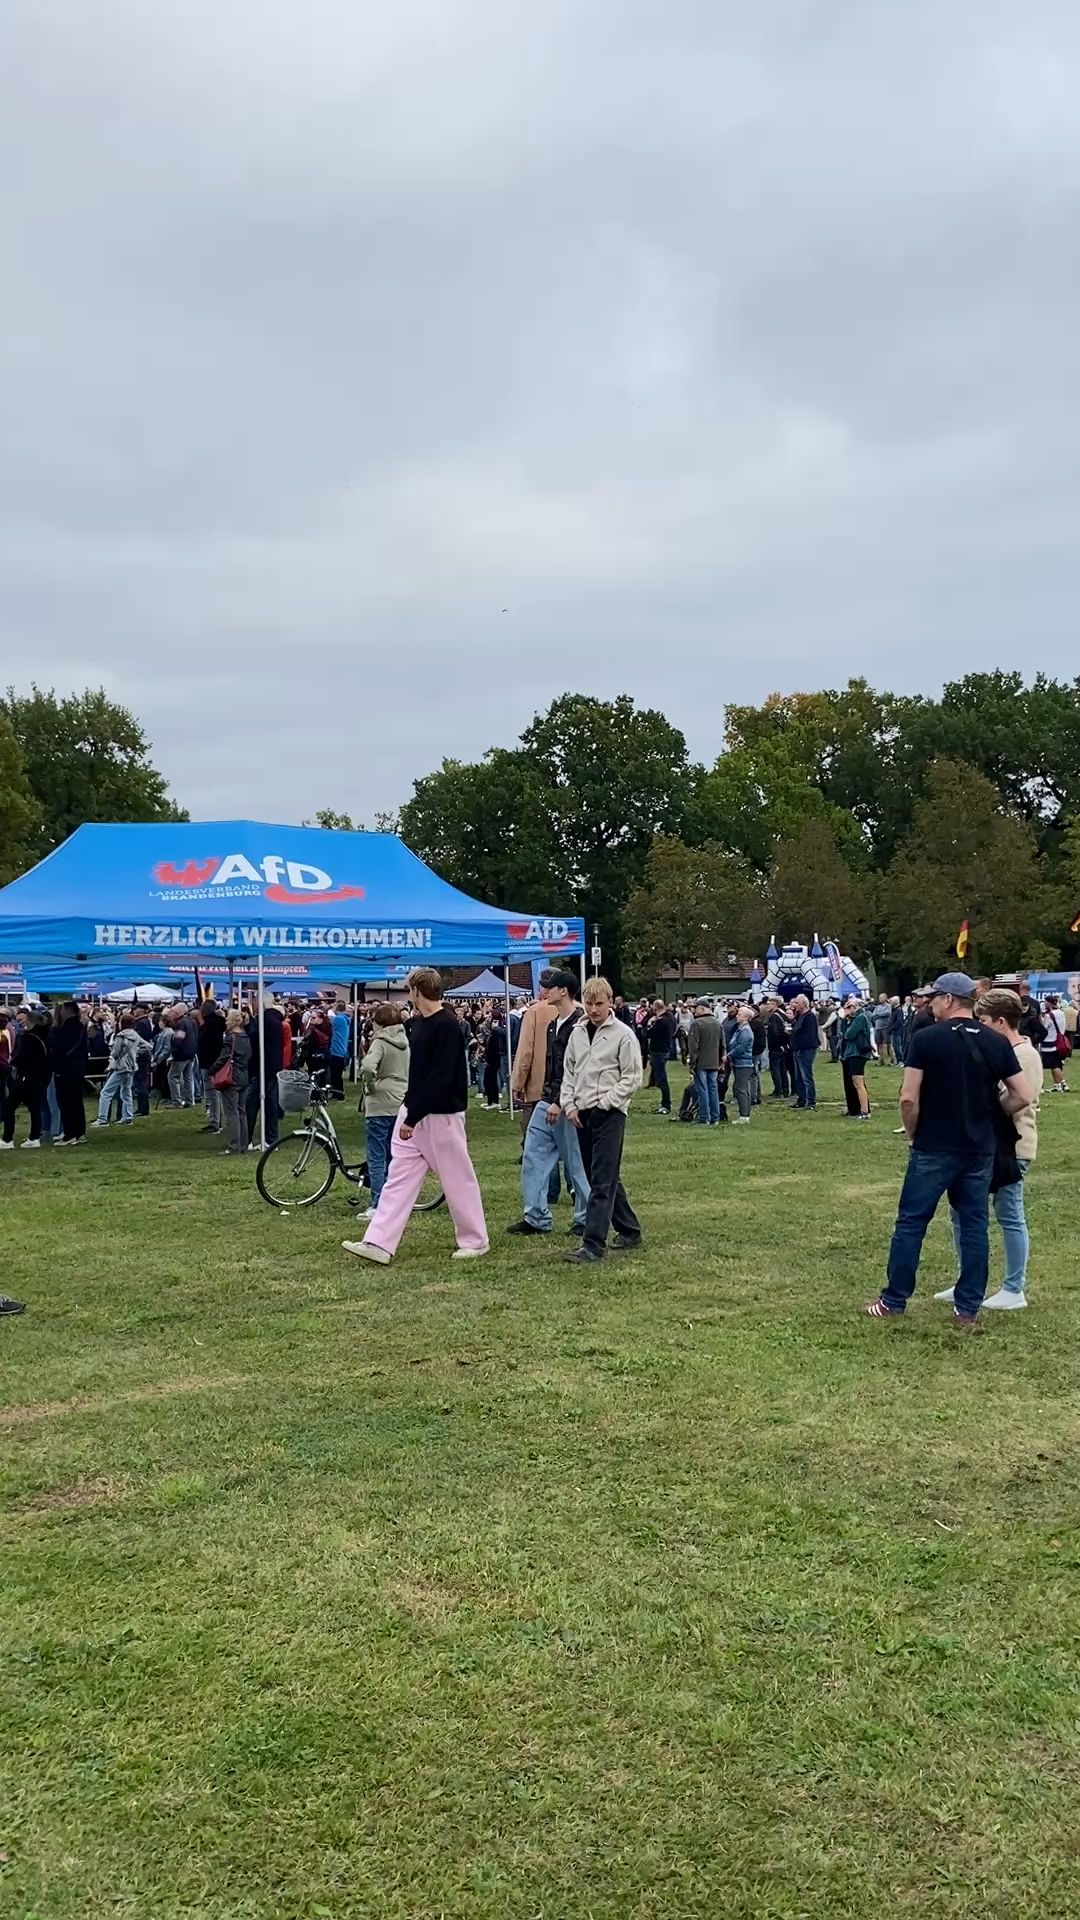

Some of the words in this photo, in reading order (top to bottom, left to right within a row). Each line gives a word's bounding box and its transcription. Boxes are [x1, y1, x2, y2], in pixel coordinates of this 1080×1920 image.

[210, 854, 333, 890] AfD
[149, 884, 260, 897] LANDESVERBAND
[161, 888, 261, 901] BRANDENBURG
[94, 924, 236, 947] HERZLICH
[240, 926, 432, 949] WILLKOMMEN!
[525, 919, 569, 940] AfD
